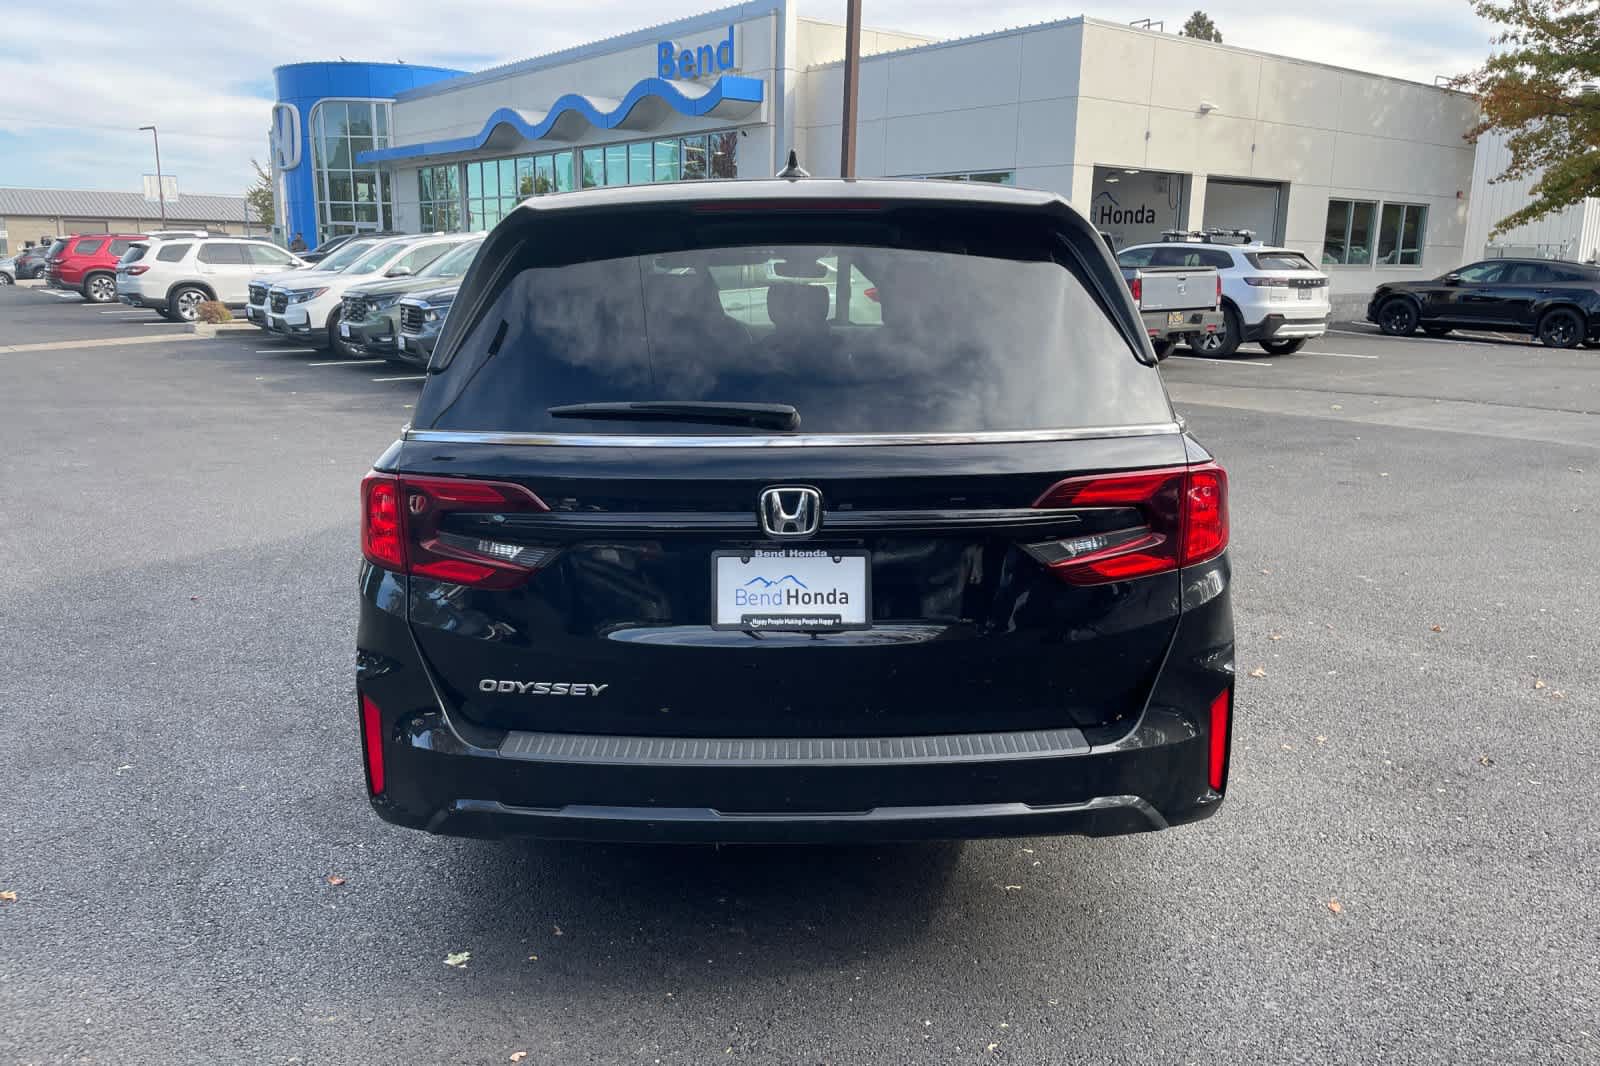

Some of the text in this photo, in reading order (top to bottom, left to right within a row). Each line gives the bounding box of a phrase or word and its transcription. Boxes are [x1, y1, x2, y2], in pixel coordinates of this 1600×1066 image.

[658, 25, 734, 80] Bend
[1100, 204, 1156, 225] Honda
[754, 549, 828, 558] Bend Honda
[478, 678, 609, 697] ODYSSEY
